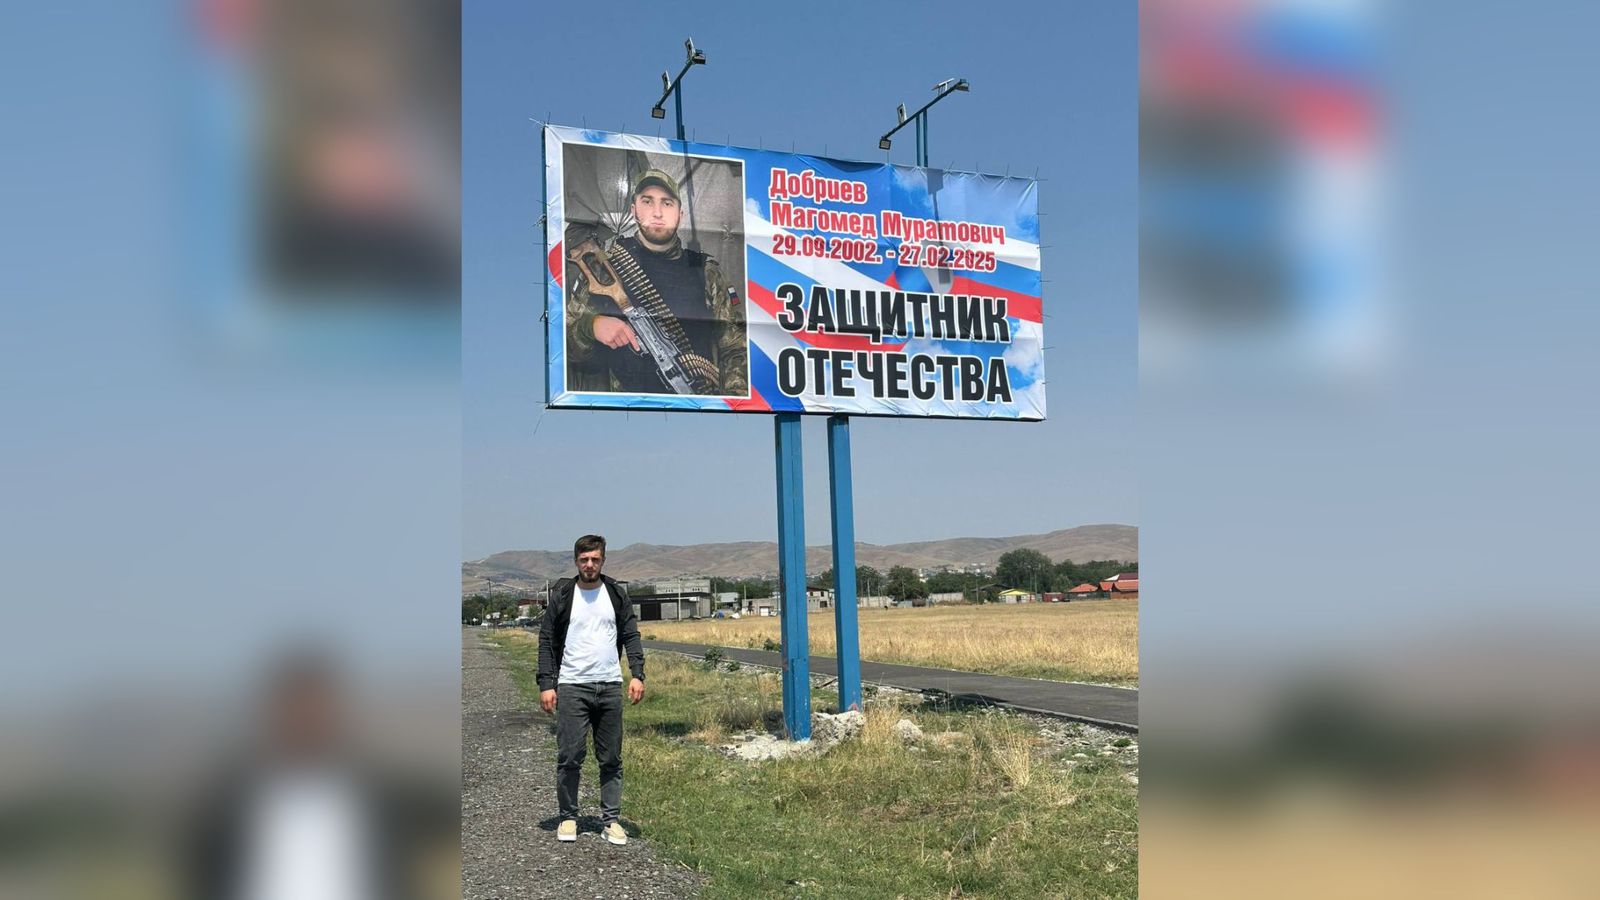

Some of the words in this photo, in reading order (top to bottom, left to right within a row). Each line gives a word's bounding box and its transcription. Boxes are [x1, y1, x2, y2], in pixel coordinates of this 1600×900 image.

[770, 170, 866, 203] Добриев
[771, 203, 877, 237] Магомед
[882, 211, 1005, 245] Муратович
[772, 234, 882, 263] 29.09.2002.
[899, 246, 996, 271] 27.02.2025
[776, 285, 1011, 343] ЗАЩИТНИК
[778, 348, 1012, 403] ОТЕЧЕСТВА
